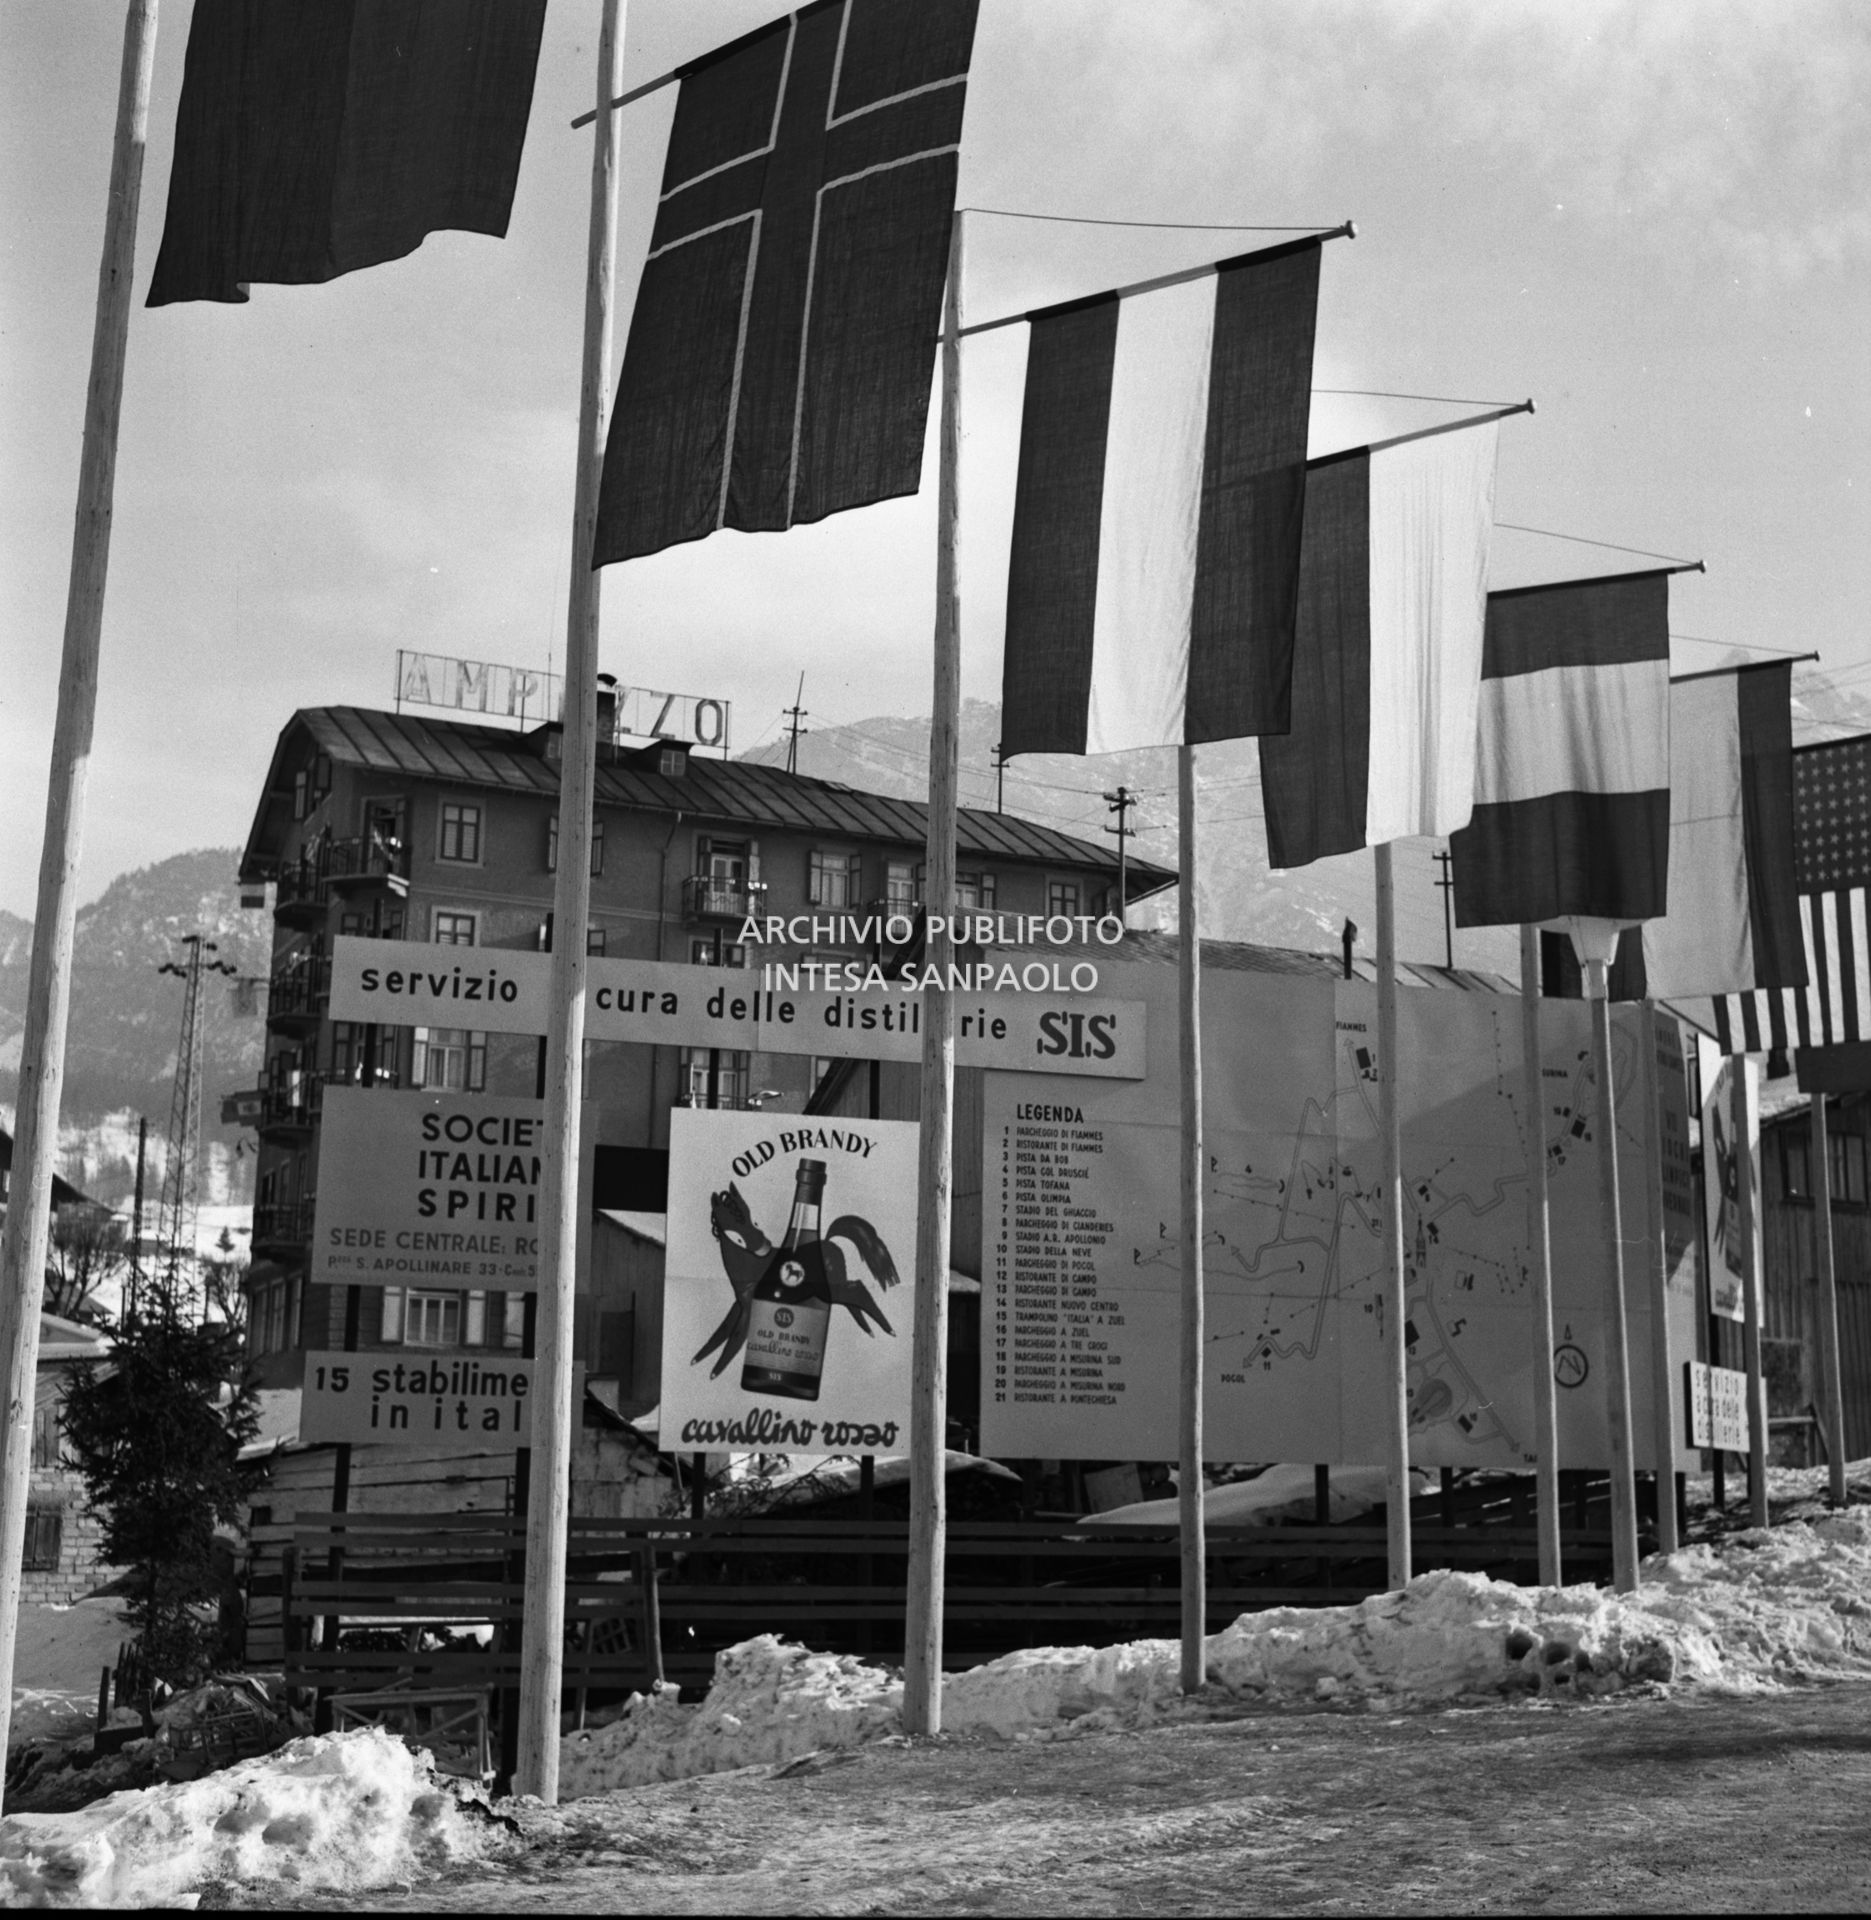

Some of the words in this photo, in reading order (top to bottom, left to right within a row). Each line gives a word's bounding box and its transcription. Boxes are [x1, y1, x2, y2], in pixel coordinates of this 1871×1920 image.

[405, 653, 723, 746] AMPZZO
[360, 966, 518, 1003] servizio
[595, 986, 678, 1015] cura
[706, 986, 795, 1023] delle
[824, 996, 1007, 1039] distilrie
[1336, 1020, 1367, 1032] FIAMMES
[1017, 1104, 1084, 1123] LEGENDA
[1004, 1126, 1009, 1135] 1
[1016, 1126, 1059, 1138] PARCHEGGIO
[1061, 1129, 1069, 1138] DI
[1071, 1129, 1103, 1141] FIAMMES
[732, 1140, 775, 1177] OLD
[779, 1128, 878, 1159] BRANDY
[1002, 1139, 1009, 1148] 2
[1016, 1139, 1057, 1151] RISTORANTE
[1061, 1142, 1069, 1151] DI
[1071, 1143, 1103, 1154] FIAMMES
[1003, 1152, 1009, 1161] 3
[1016, 1152, 1036, 1163] PISTA
[1040, 1154, 1050, 1163] DA
[1055, 1155, 1069, 1164] BOB
[1002, 1165, 1008, 1174] 4
[1016, 1165, 1036, 1176] PISTA
[1040, 1167, 1054, 1177] COL
[1002, 1178, 1008, 1188] 5
[1016, 1179, 1036, 1189] PISTA
[1040, 1180, 1070, 1190] TOFANA
[1002, 1191, 1008, 1201] 6
[1016, 1192, 1036, 1202] PISTA
[1041, 1193, 1071, 1204] OLIMPIA
[418, 1188, 535, 1223] SPIRI
[1002, 1204, 1008, 1213] 7
[1016, 1205, 1041, 1215] STADIO
[1045, 1207, 1058, 1217] DEL
[1063, 1208, 1097, 1218] GHIACCIO
[1002, 1217, 1007, 1227] 8
[1016, 1218, 1058, 1229] PARCHEGGIO
[1061, 1221, 1069, 1230] DI
[330, 1228, 386, 1249] SEDE
[1002, 1231, 1007, 1240] 9
[1016, 1232, 1040, 1242] STADIO
[1064, 1234, 1106, 1245] APOLLONIO
[996, 1244, 1007, 1254] 10
[1015, 1245, 1040, 1255] STADIO
[1045, 1246, 1067, 1256] DELLA
[1072, 1248, 1092, 1257] NEVE
[373, 1258, 471, 1275] APOLLINARE
[996, 1257, 1007, 1267] 11
[1015, 1258, 1057, 1269] PARCHEGGIO
[1061, 1260, 1068, 1270] DI
[1072, 1261, 1095, 1271] POCOL
[996, 1270, 1008, 1280] 12
[1015, 1271, 1057, 1282] RISTORANTE
[1061, 1273, 1069, 1283] DI
[1072, 1274, 1097, 1284] CAMPO
[996, 1284, 1007, 1294] 13
[1015, 1284, 1058, 1296] PARCHEGGIO
[1061, 1286, 1069, 1296] DI
[1072, 1287, 1097, 1297] CAMPO
[996, 1298, 1007, 1307] 14
[1015, 1298, 1057, 1310] RISTORANTE
[1061, 1301, 1087, 1311] NUOVO
[1090, 1301, 1119, 1312] CENTRO
[996, 1311, 1007, 1321] 15
[1015, 1311, 1058, 1323] TRAMPOLINO
[1097, 1316, 1103, 1325] A
[1108, 1316, 1125, 1326] ZUEL
[757, 1328, 774, 1338] OLD
[778, 1332, 810, 1345] BRANDY
[996, 1325, 1007, 1334] 16
[1015, 1325, 1057, 1336] PARCHEGGIO
[1060, 1327, 1066, 1336] A
[1072, 1327, 1090, 1338] ZUEL
[996, 1338, 1007, 1348] 17
[1015, 1339, 1057, 1349] PARCHEGGIO
[1060, 1340, 1066, 1349] A
[1070, 1340, 1082, 1350] TRE
[996, 1351, 1007, 1361] 18
[1014, 1352, 1057, 1363] PARCHEGGIO
[1060, 1353, 1066, 1363] A
[996, 1365, 1007, 1375] 19
[1014, 1365, 1057, 1376] RISTORANTE
[1060, 1367, 1066, 1376] A
[315, 1367, 350, 1393] 15
[995, 1379, 1006, 1389] 20
[1014, 1379, 1057, 1390] PARCHEGGIO
[1060, 1381, 1066, 1390] A
[995, 1392, 1006, 1402] 21
[1014, 1393, 1055, 1403] RISTORANTE
[1060, 1394, 1066, 1403] A
[371, 1395, 408, 1429] in
[681, 1407, 817, 1445] cavallino
[821, 1419, 900, 1447] rosso
